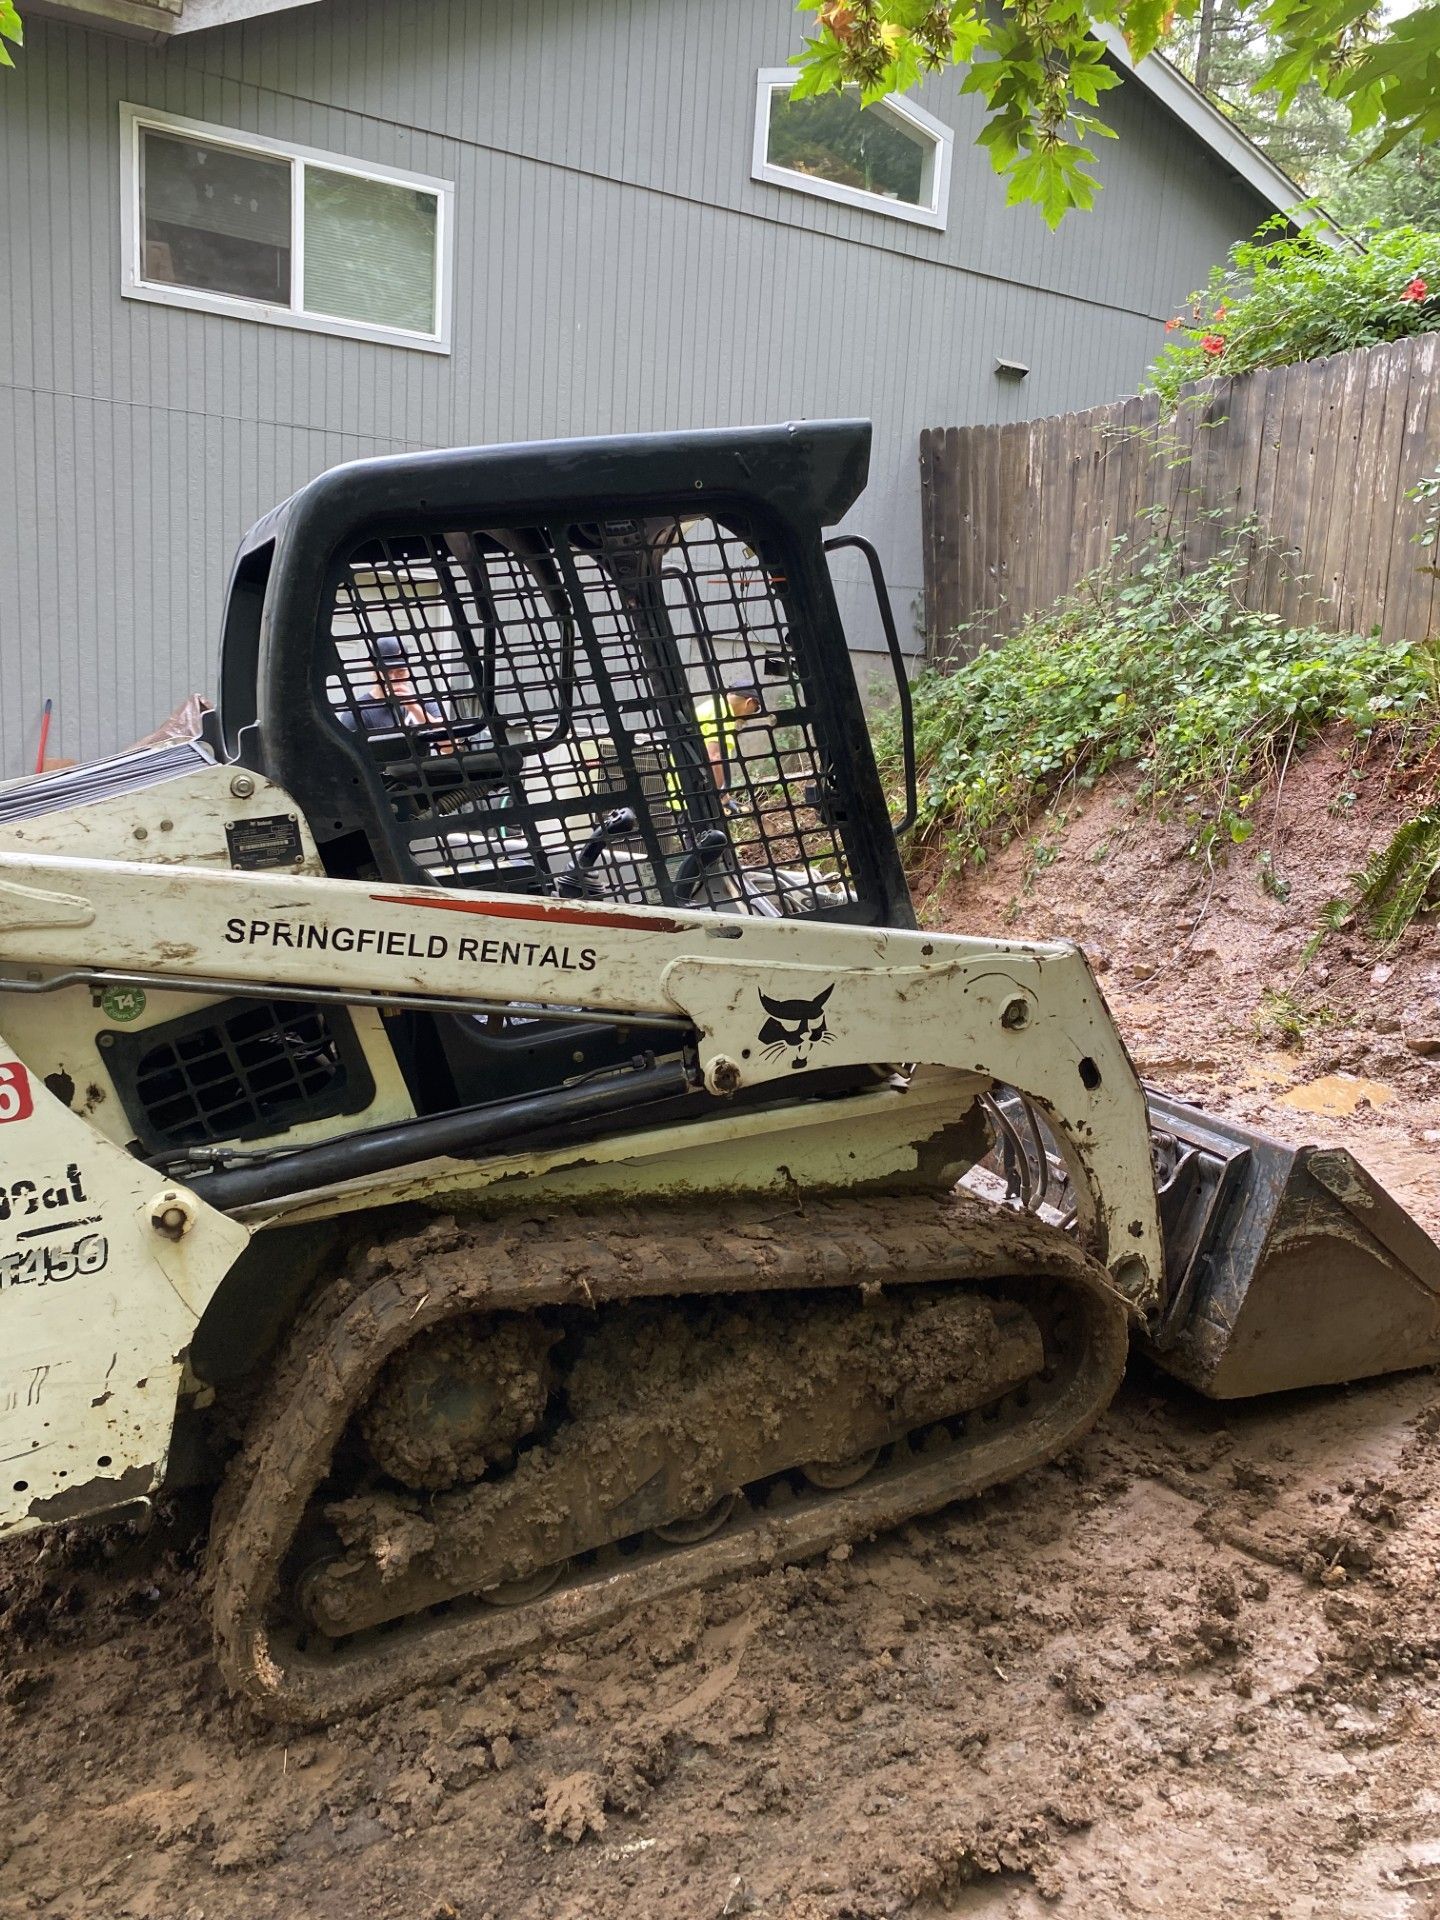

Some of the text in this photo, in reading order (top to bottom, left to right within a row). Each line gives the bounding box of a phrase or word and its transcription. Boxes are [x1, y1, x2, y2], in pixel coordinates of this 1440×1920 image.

[224, 918, 597, 971] SPRINGFIELD RENTALS
[114, 994, 135, 1010] T4
